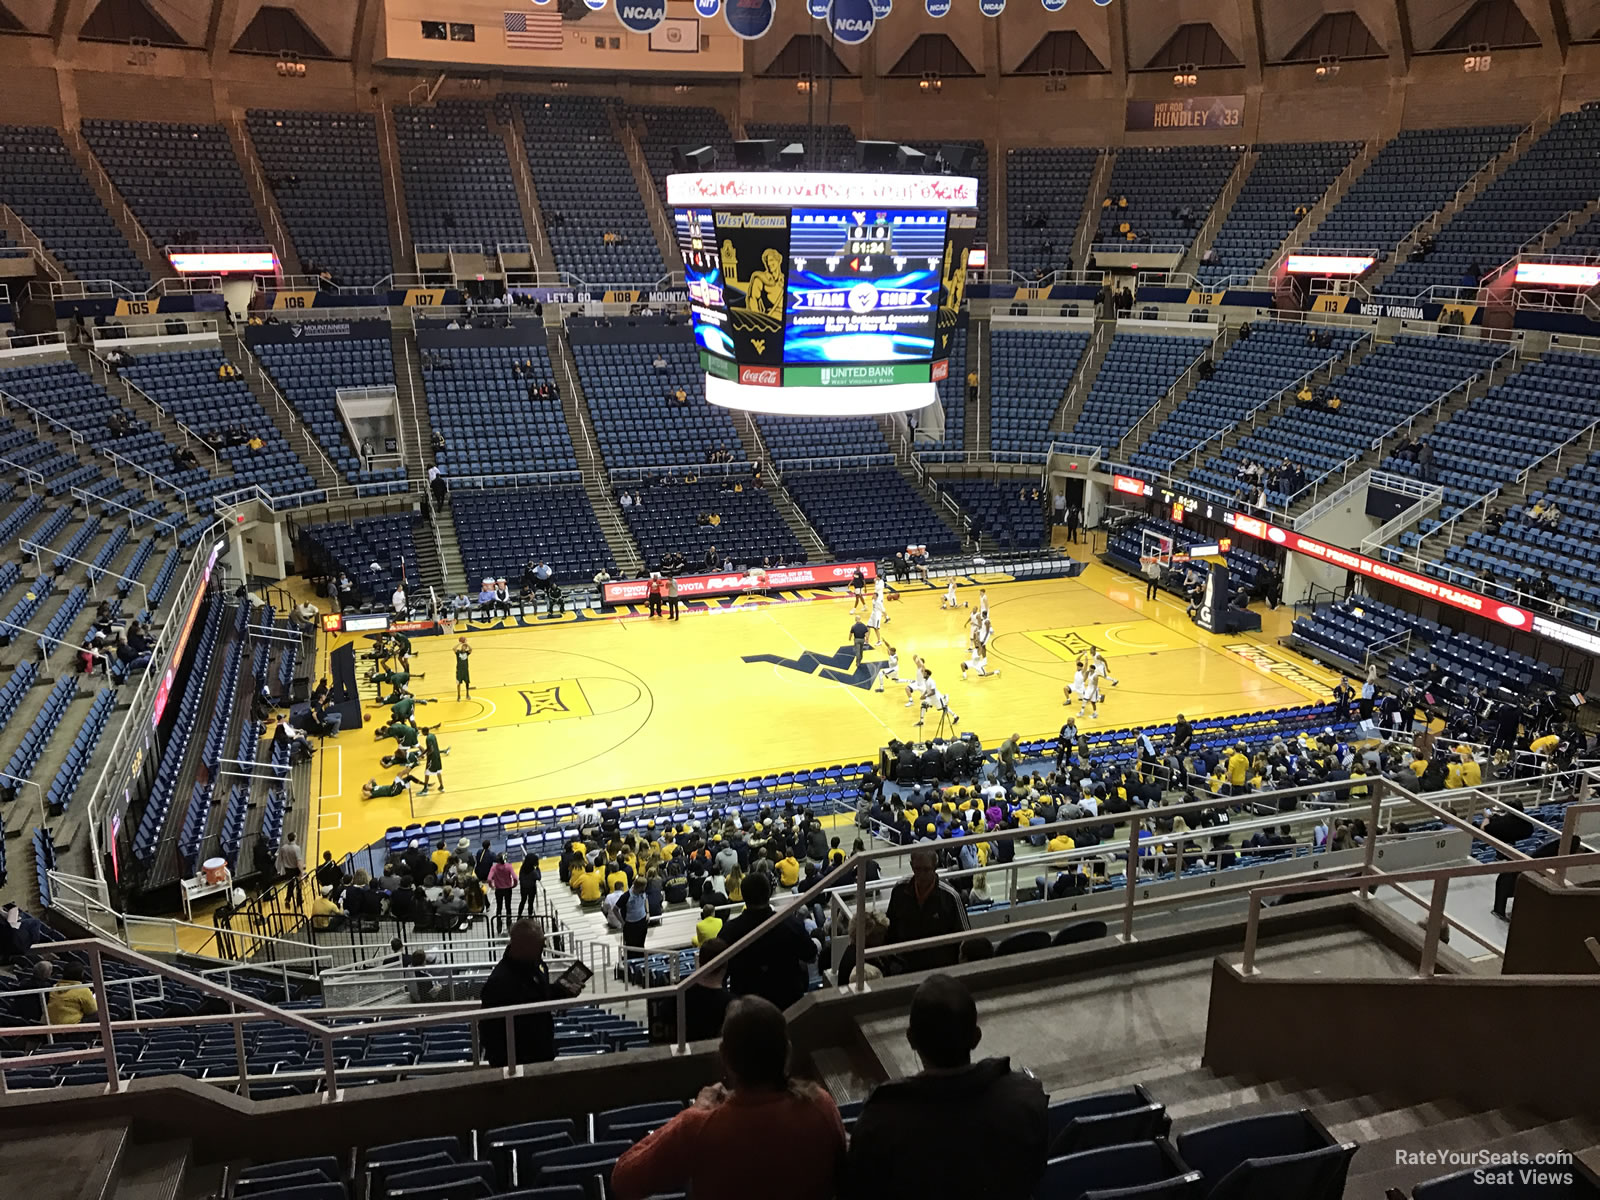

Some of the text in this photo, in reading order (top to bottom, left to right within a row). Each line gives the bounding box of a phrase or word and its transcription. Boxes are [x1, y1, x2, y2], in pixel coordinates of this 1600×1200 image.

[698, 0, 715, 8] NIT
[623, 7, 664, 20] NCAA
[836, 18, 872, 31] NCAA
[1464, 56, 1492, 72] 218
[1170, 103, 1183, 111] ROD
[1154, 109, 1239, 127] HUNDLEY 33
[744, 214, 786, 226] VIRGINIA
[285, 297, 304, 309] 106
[415, 295, 433, 305] 107
[547, 292, 591, 303] LET'S GO
[613, 292, 631, 303] 108
[807, 292, 917, 306] TEAM SHOP
[1199, 295, 1212, 304] 112
[127, 302, 149, 315] 105
[1324, 301, 1338, 312] 113
[1360, 304, 1424, 320] WEST VIRGINIA
[831, 367, 895, 378] UNITED BANK
[678, 582, 704, 591] OYOTA
[1201, 606, 1211, 623] G
[1436, 840, 1446, 849] 10
[1378, 850, 1384, 858] 9
[1259, 870, 1265, 880] 7
[1210, 878, 1216, 887] 6
[1143, 890, 1149, 899] 5
